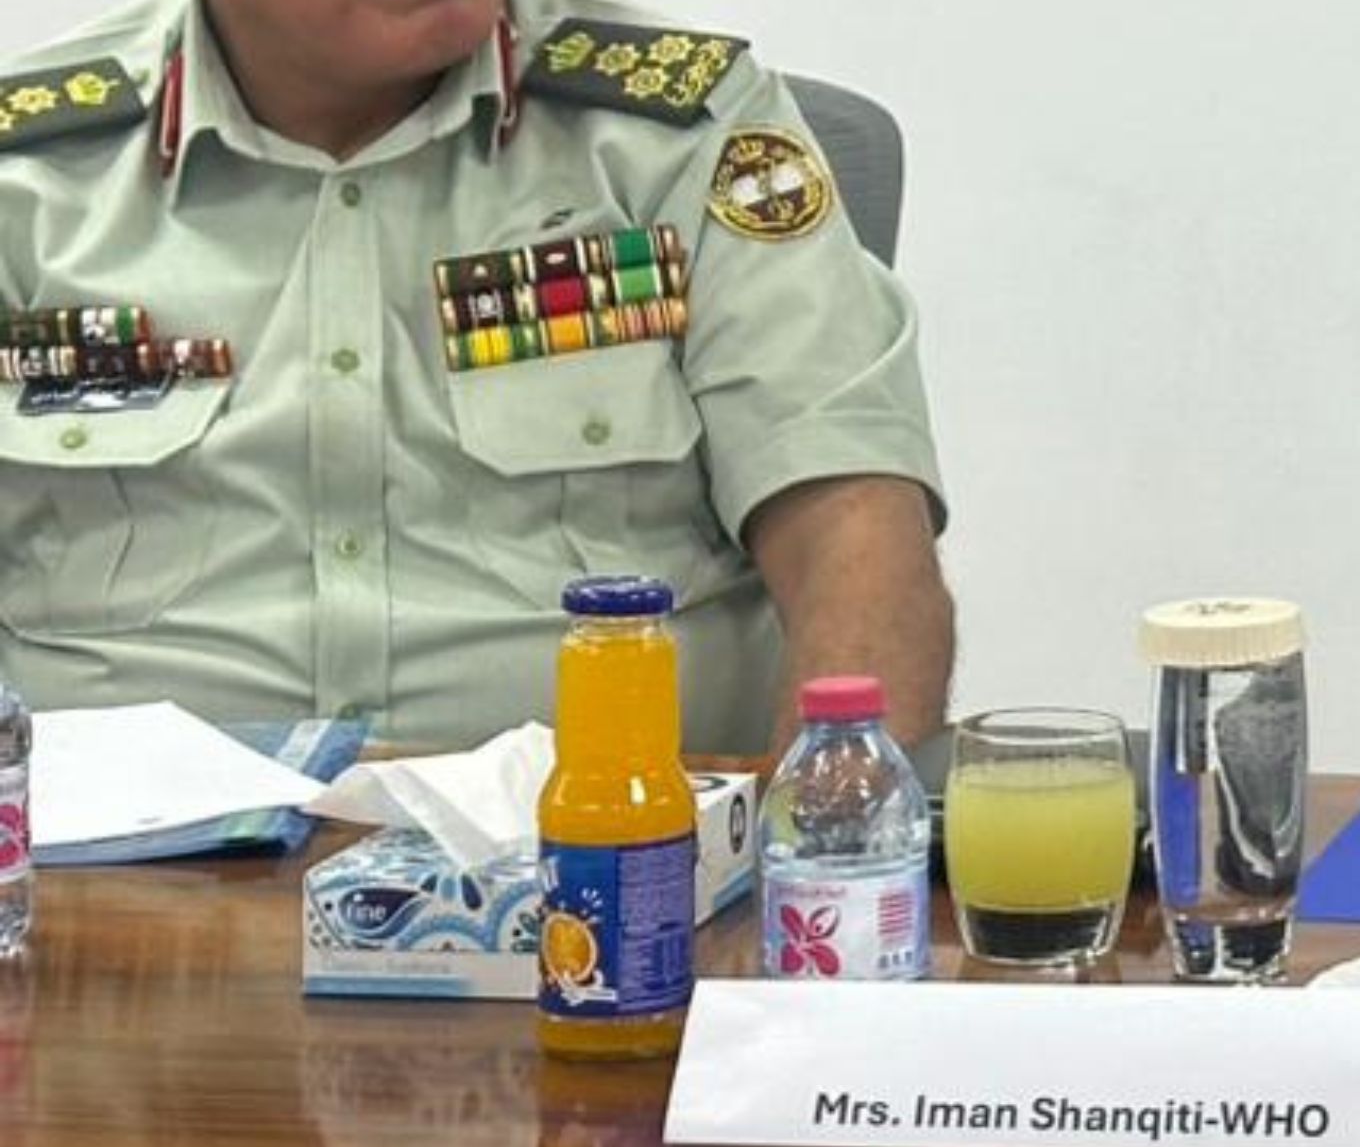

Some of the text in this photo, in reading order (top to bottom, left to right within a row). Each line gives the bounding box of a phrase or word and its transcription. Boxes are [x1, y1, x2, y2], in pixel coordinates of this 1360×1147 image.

[345, 893, 387, 921] fine
[813, 1092, 1331, 1141] Mrs. Iman Shanqiti-WHO
